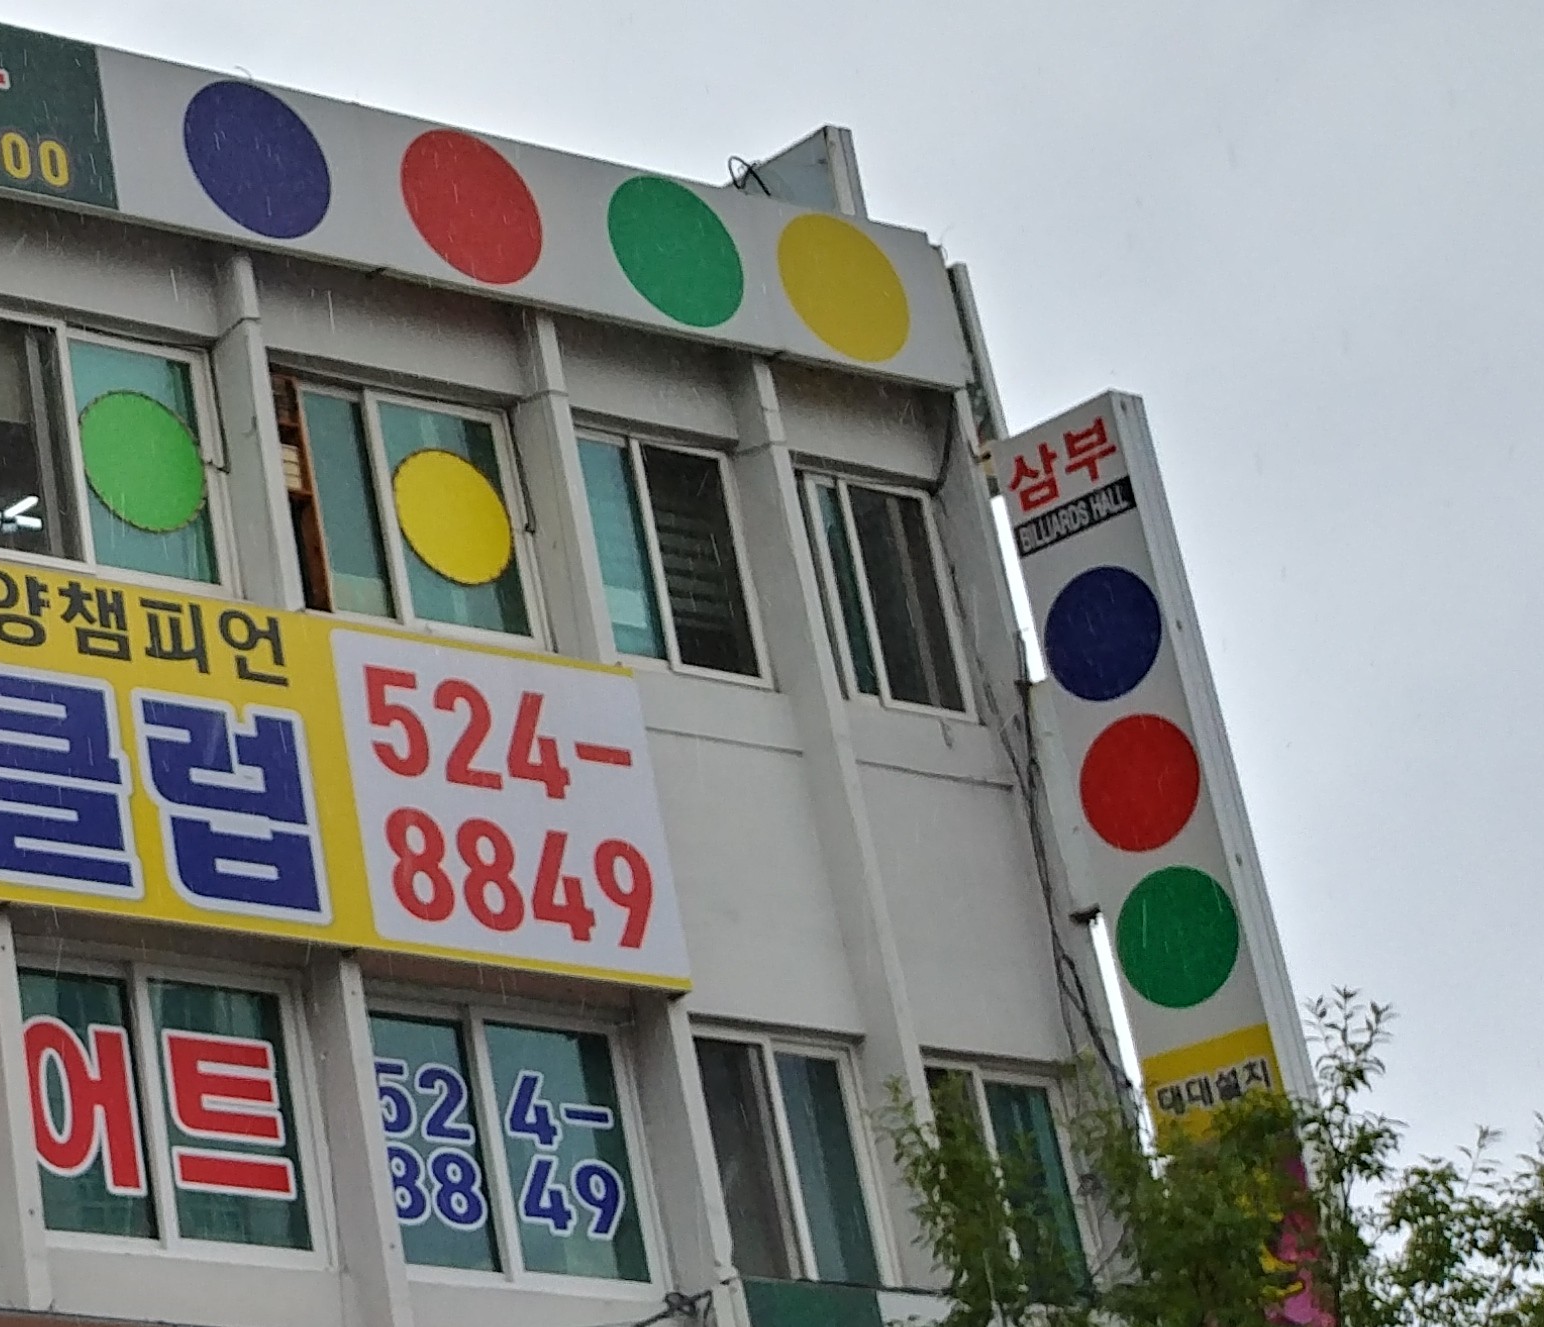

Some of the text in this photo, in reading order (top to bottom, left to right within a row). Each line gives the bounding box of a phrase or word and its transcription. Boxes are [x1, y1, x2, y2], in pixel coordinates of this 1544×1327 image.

[1008, 416, 1117, 512] 삼부
[1019, 484, 1130, 553] BILLIARDS HALL
[363, 663, 634, 800] 524-
[383, 807, 655, 950] 8849
